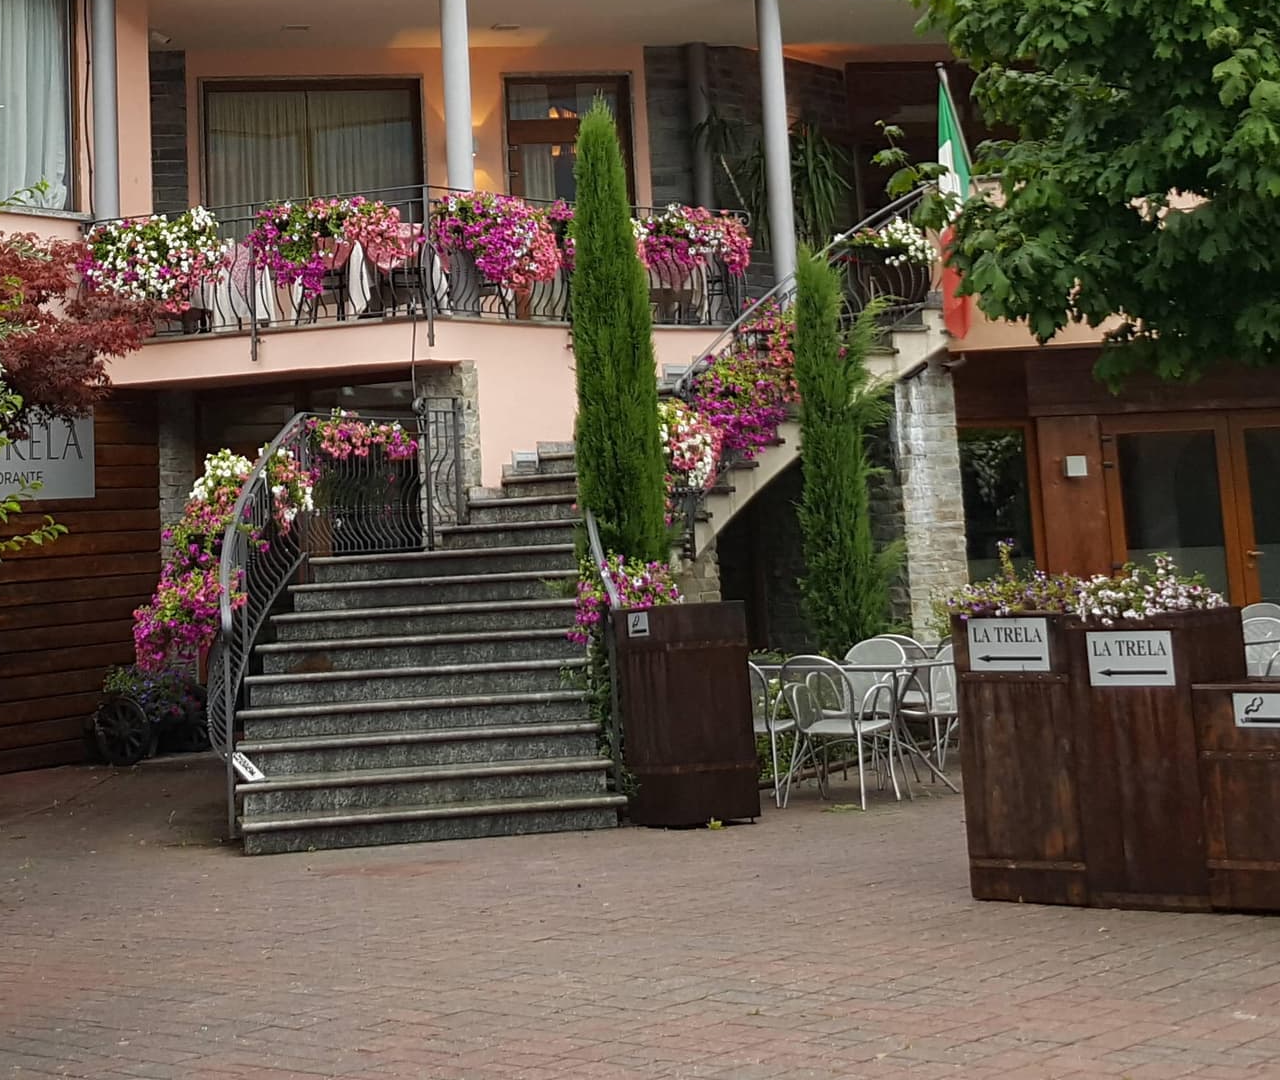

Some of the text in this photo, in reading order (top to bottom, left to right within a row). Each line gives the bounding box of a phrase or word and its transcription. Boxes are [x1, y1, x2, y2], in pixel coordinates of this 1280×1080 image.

[972, 626, 1043, 643] LA TRELA
[1092, 640, 1168, 657] LA TRELA
